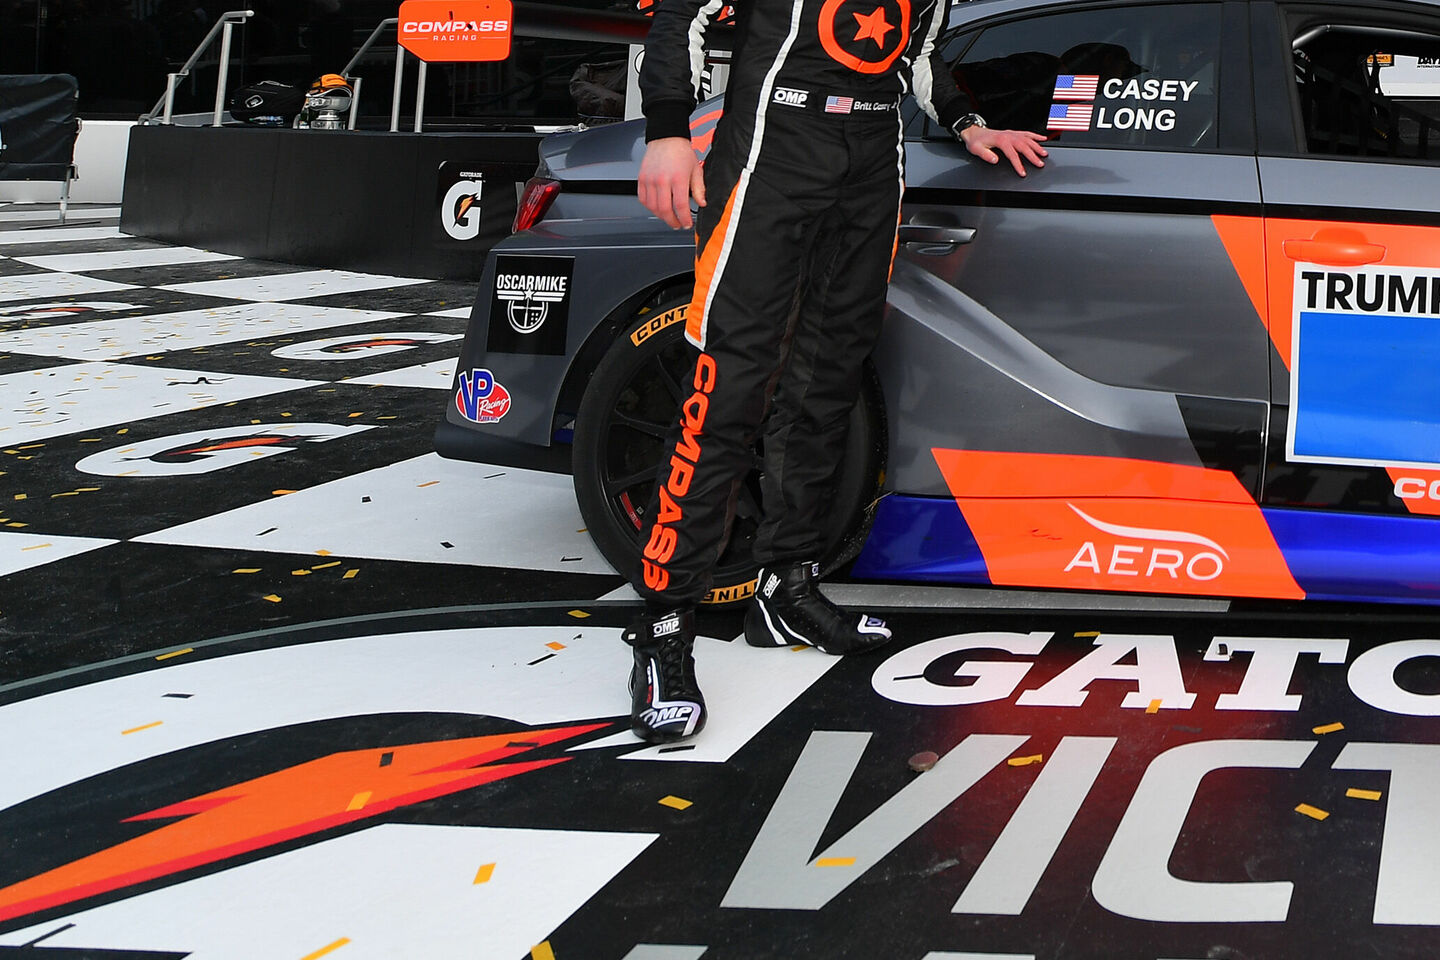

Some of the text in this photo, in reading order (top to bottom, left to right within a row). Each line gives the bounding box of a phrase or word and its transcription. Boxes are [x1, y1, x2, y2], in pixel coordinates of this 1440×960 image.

[403, 21, 508, 33] COMPASS
[774, 90, 808, 105] OMP
[1102, 78, 1198, 102] CASEY
[1096, 108, 1176, 131] LONG
[496, 274, 568, 291] OSCARMIKE
[479, 397, 510, 415] Racing
[1063, 541, 1224, 581] AERO
[763, 574, 779, 598] OMP
[653, 618, 680, 633] OMP
[642, 705, 693, 727] OMP
